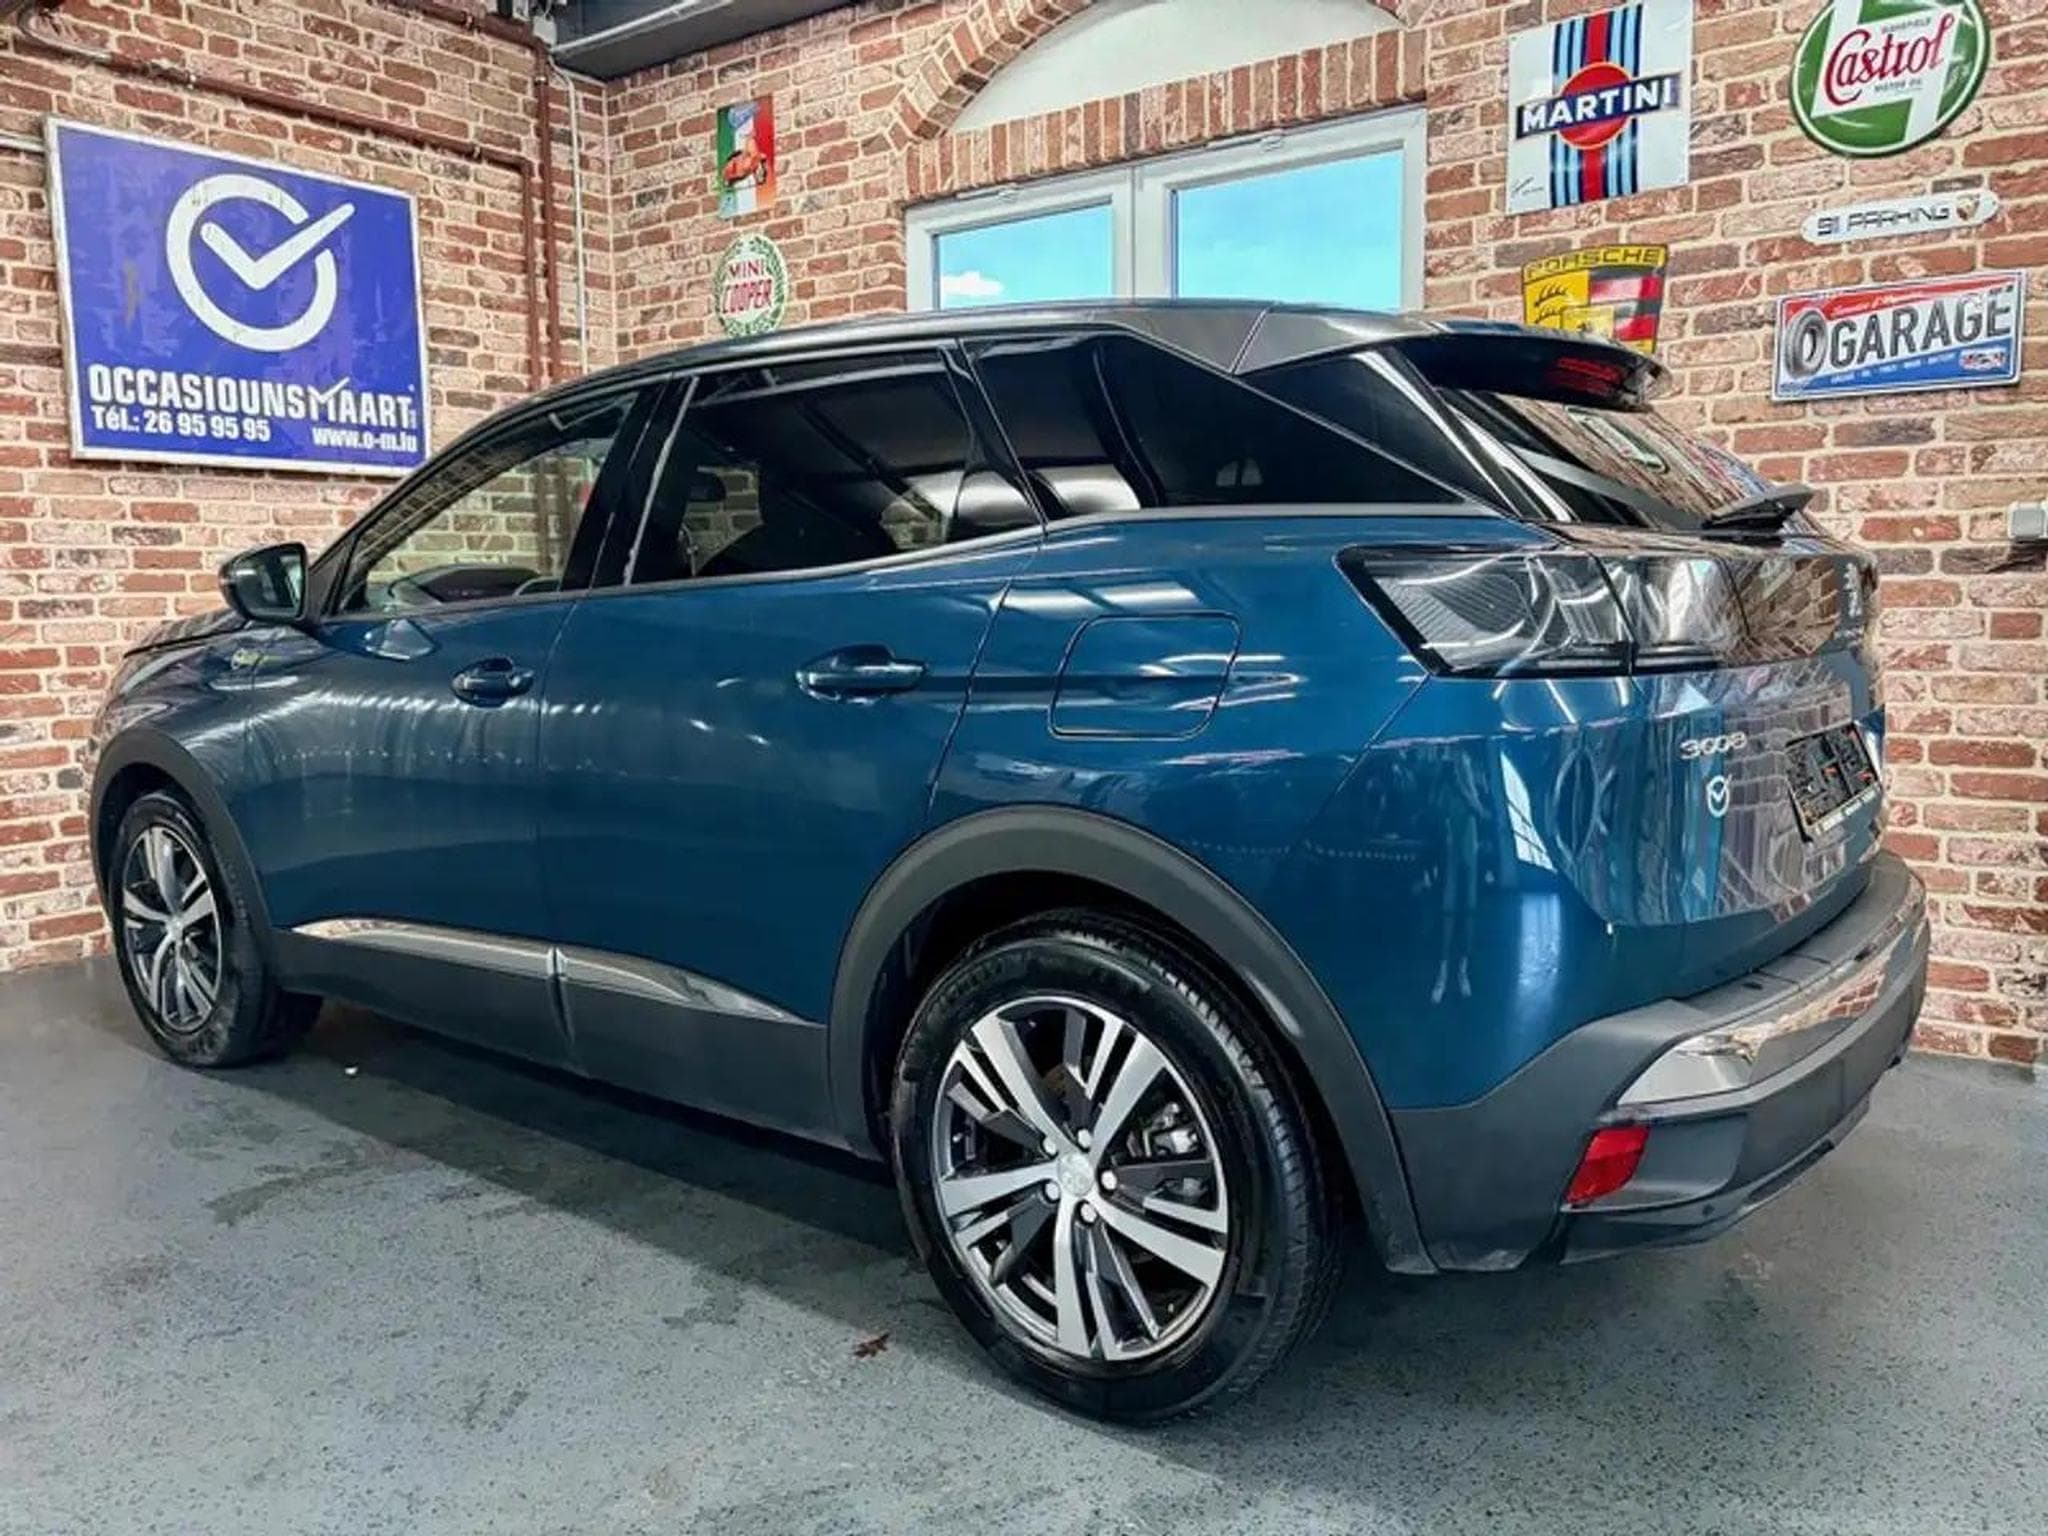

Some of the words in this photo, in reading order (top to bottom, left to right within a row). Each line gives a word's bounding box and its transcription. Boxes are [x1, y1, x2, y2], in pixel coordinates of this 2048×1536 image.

[1825, 13, 1954, 106] Castrol
[1522, 78, 1671, 133] MARTINI
[727, 259, 764, 278] MINI
[1527, 248, 1660, 278] PORSCHE
[722, 279, 772, 314] COOPER
[143, 410, 173, 434] 26
[177, 412, 206, 437] 95
[210, 415, 239, 440] 95
[242, 417, 271, 442] 95
[1680, 731, 1747, 759] 3008
